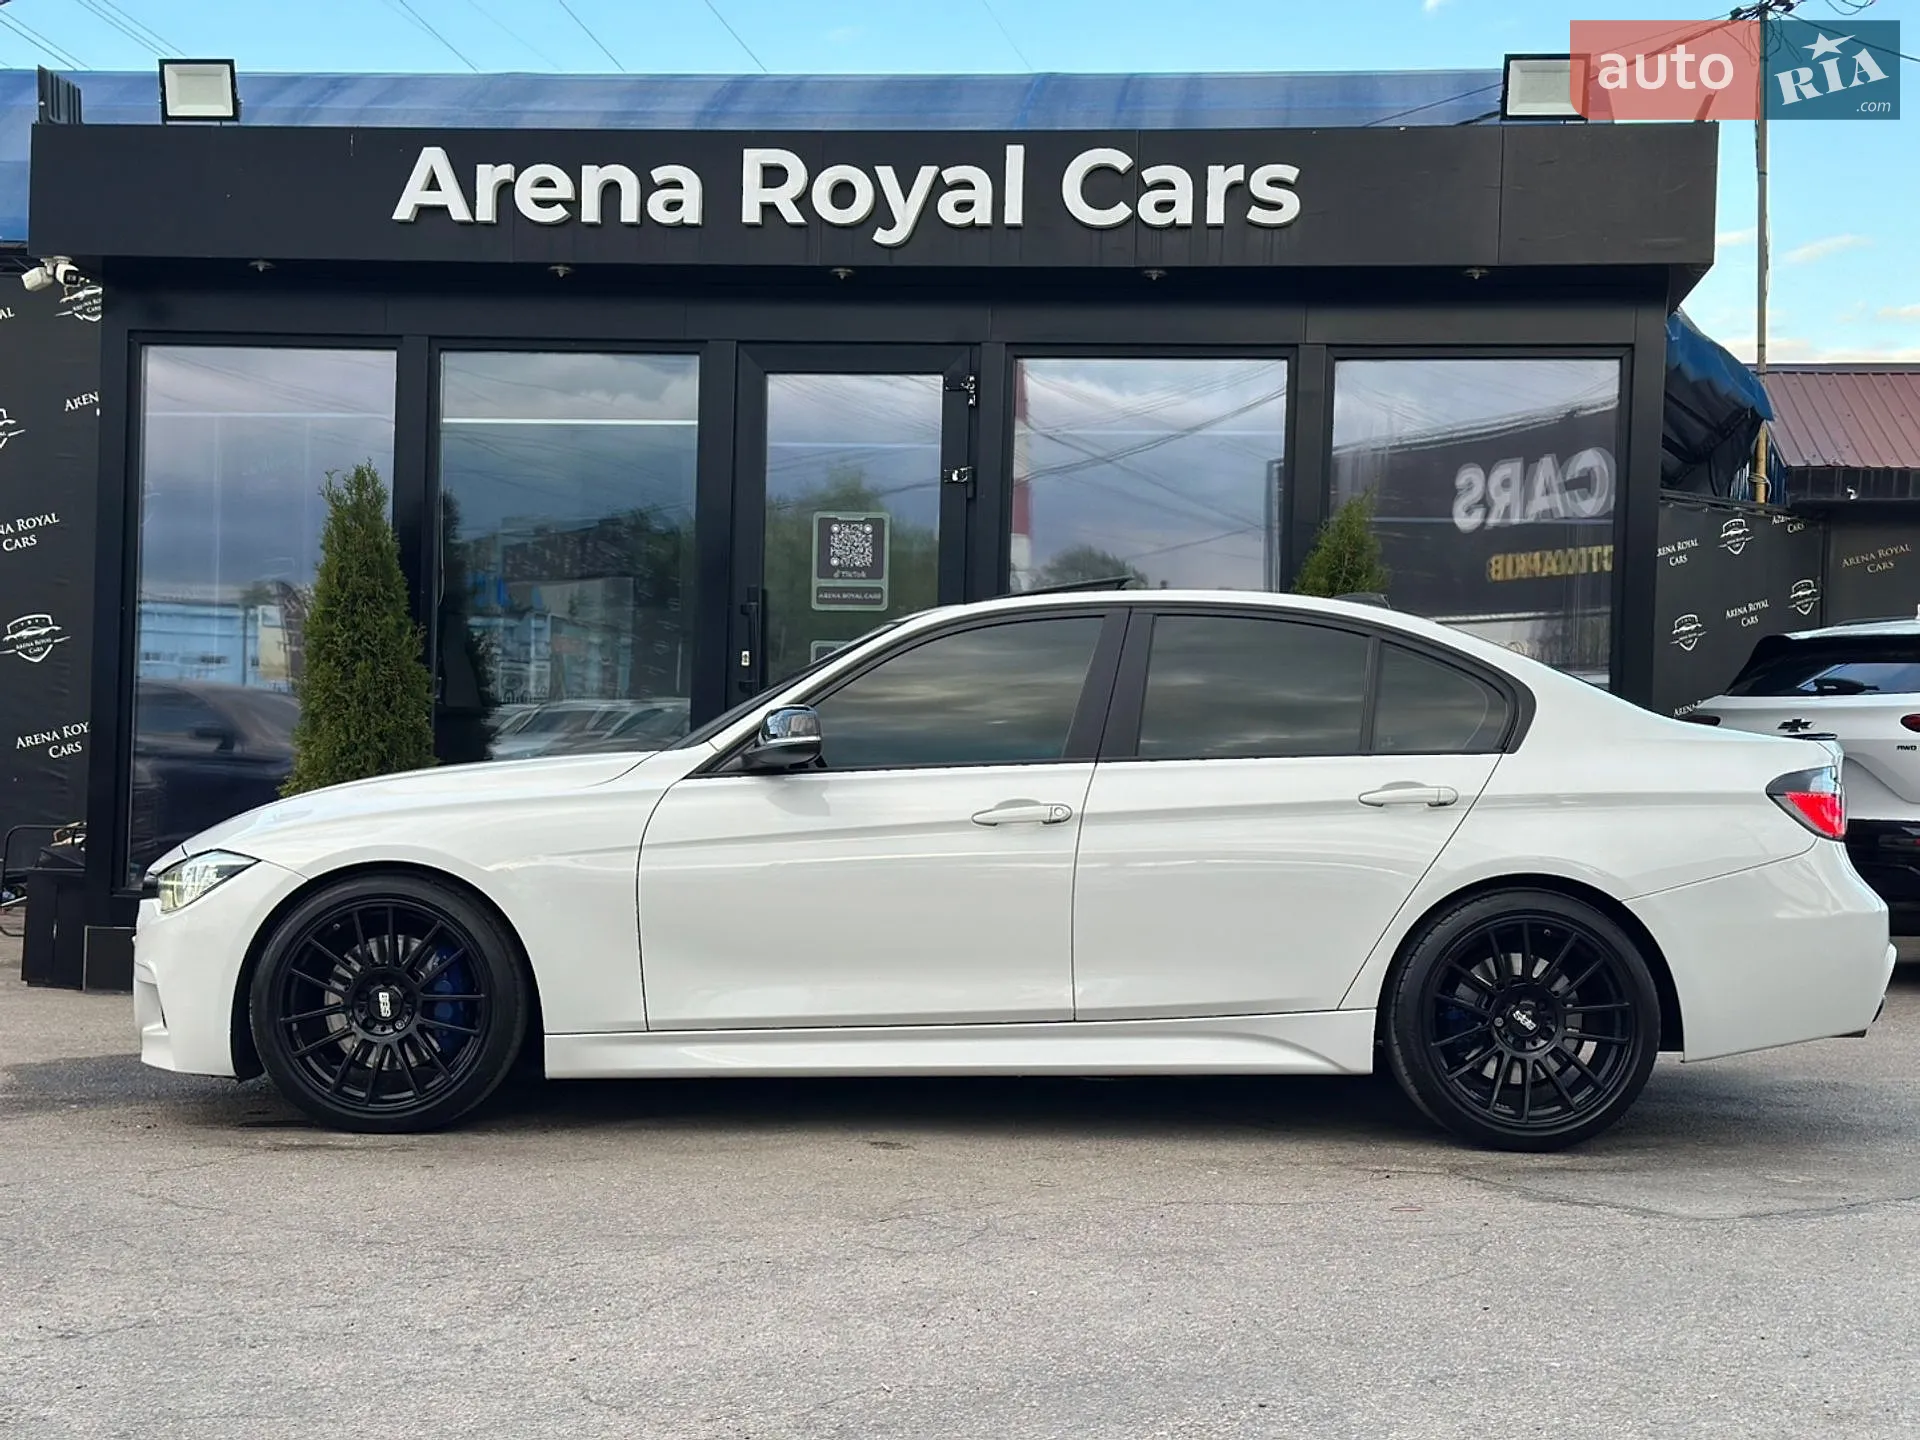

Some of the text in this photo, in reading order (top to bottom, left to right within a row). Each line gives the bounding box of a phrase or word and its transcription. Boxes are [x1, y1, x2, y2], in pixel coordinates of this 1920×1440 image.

[391, 144, 1301, 248] Arena Royal Cars
[16, 512, 60, 532] ROYAL
[2, 534, 37, 552] CARS
[1842, 543, 1912, 568] ARENA ROYAL
[1866, 560, 1895, 573] CARS
[1725, 599, 1769, 619] ARENA ROYAL
[1741, 615, 1759, 627] CARS
[16, 730, 60, 750] ARENA
[48, 741, 82, 758] CARS
